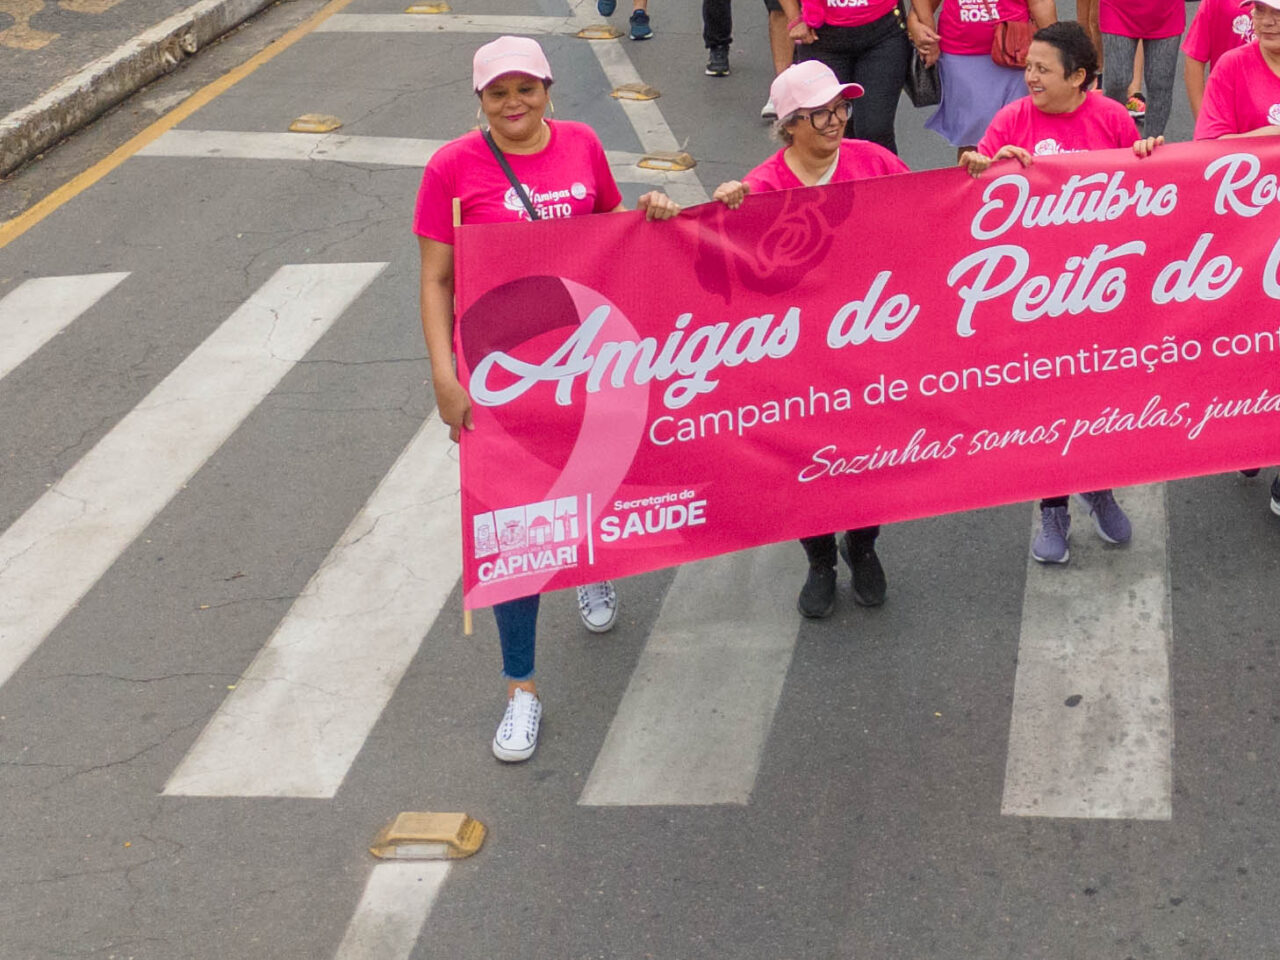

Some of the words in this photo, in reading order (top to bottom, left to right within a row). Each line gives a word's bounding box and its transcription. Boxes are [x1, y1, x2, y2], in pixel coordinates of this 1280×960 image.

[960, 8, 1000, 22] ROSA
[534, 189, 570, 203] Amigas
[970, 171, 1178, 240] Outubro
[469, 304, 801, 410] Amigas
[827, 270, 920, 349] de
[947, 240, 1146, 338] Peito
[1151, 233, 1243, 305] de
[649, 385, 852, 446] Campanha
[863, 374, 908, 406] de
[919, 335, 1202, 396] conscientização
[797, 427, 964, 483] Sozinhas
[967, 417, 1061, 456] somos
[1062, 394, 1192, 456] pétalas,
[600, 500, 707, 542] SAÚDE
[614, 493, 677, 511] Secretaria
[678, 489, 695, 502] da
[478, 545, 578, 582] CAPIVARI
